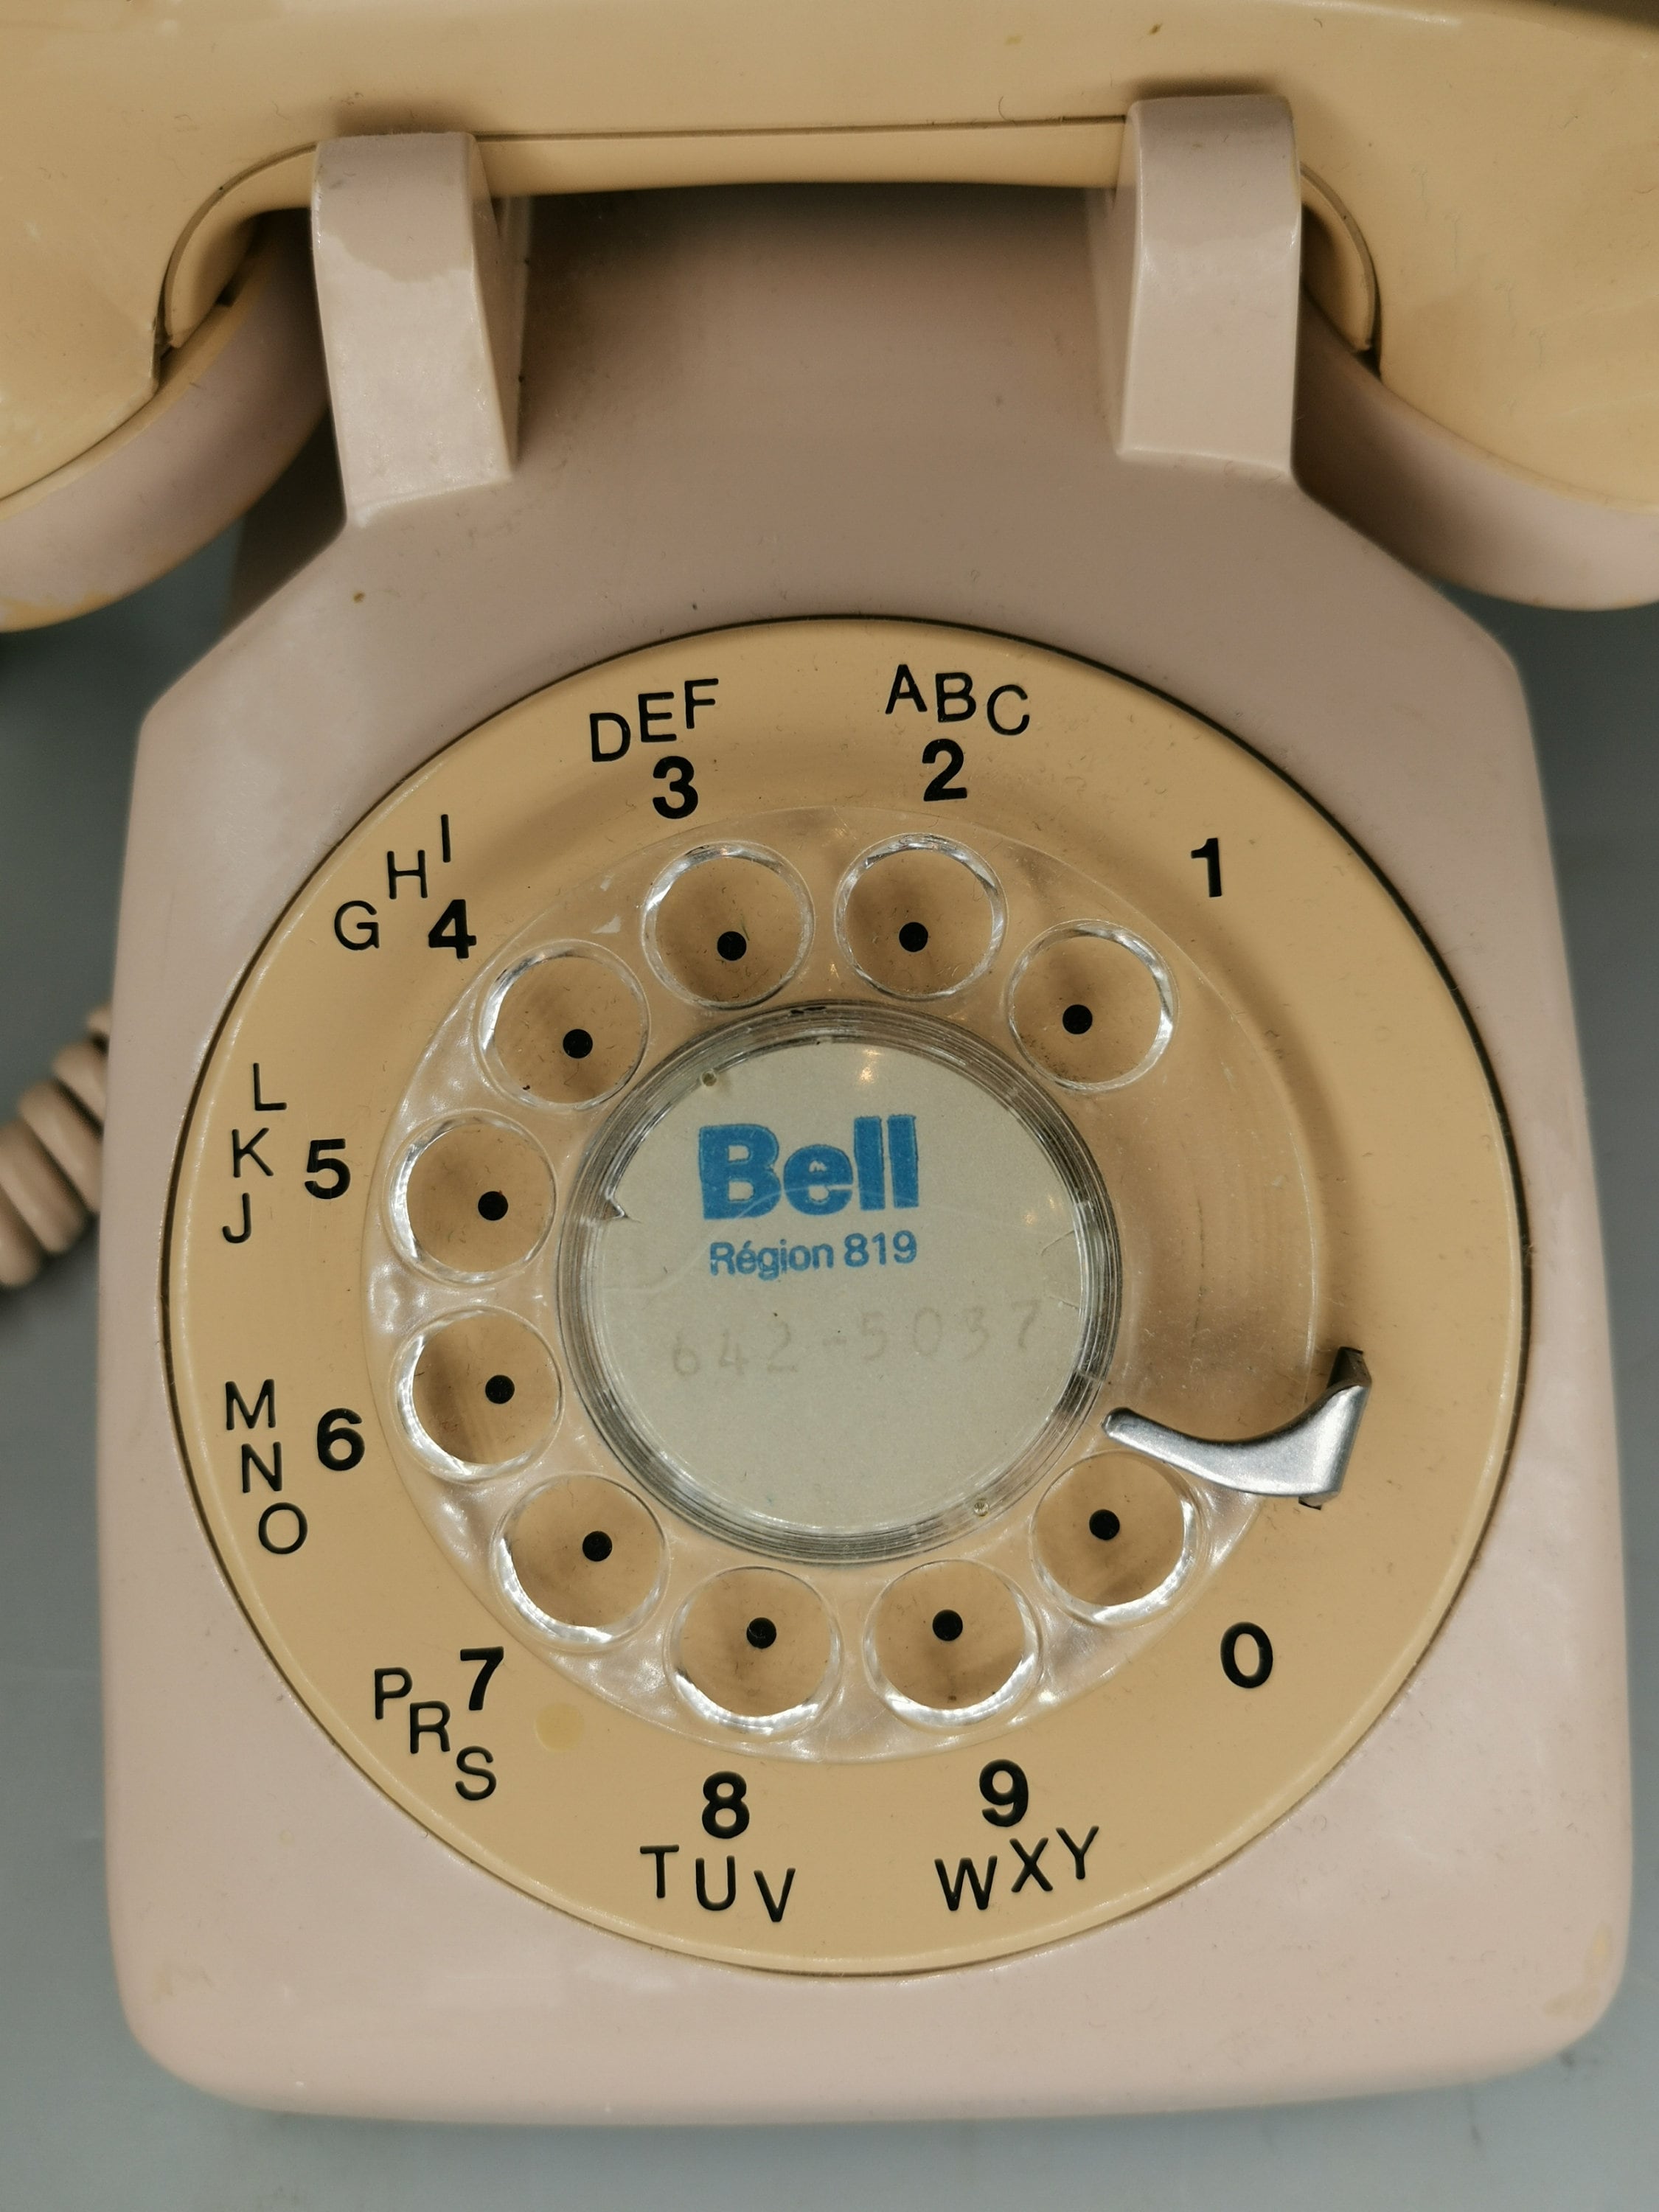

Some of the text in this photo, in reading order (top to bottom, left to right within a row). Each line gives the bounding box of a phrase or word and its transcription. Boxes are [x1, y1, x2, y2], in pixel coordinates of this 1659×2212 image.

[590, 678, 718, 762] DEF
[886, 664, 1029, 735] ABC
[652, 755, 699, 820] 3
[922, 738, 968, 802] 2
[1189, 836, 1223, 899] 1
[427, 899, 477, 959] 4
[304, 1138, 351, 1200] 5
[698, 1115, 919, 1220] Bell
[710, 1231, 917, 1281] Région 819
[316, 1408, 365, 1472] 6
[459, 1646, 504, 1711] 7
[701, 1772, 750, 1840] 8
[978, 1759, 1029, 1828] 9
[640, 1845, 796, 1923] TUV
[934, 1826, 1099, 1912] WXY
